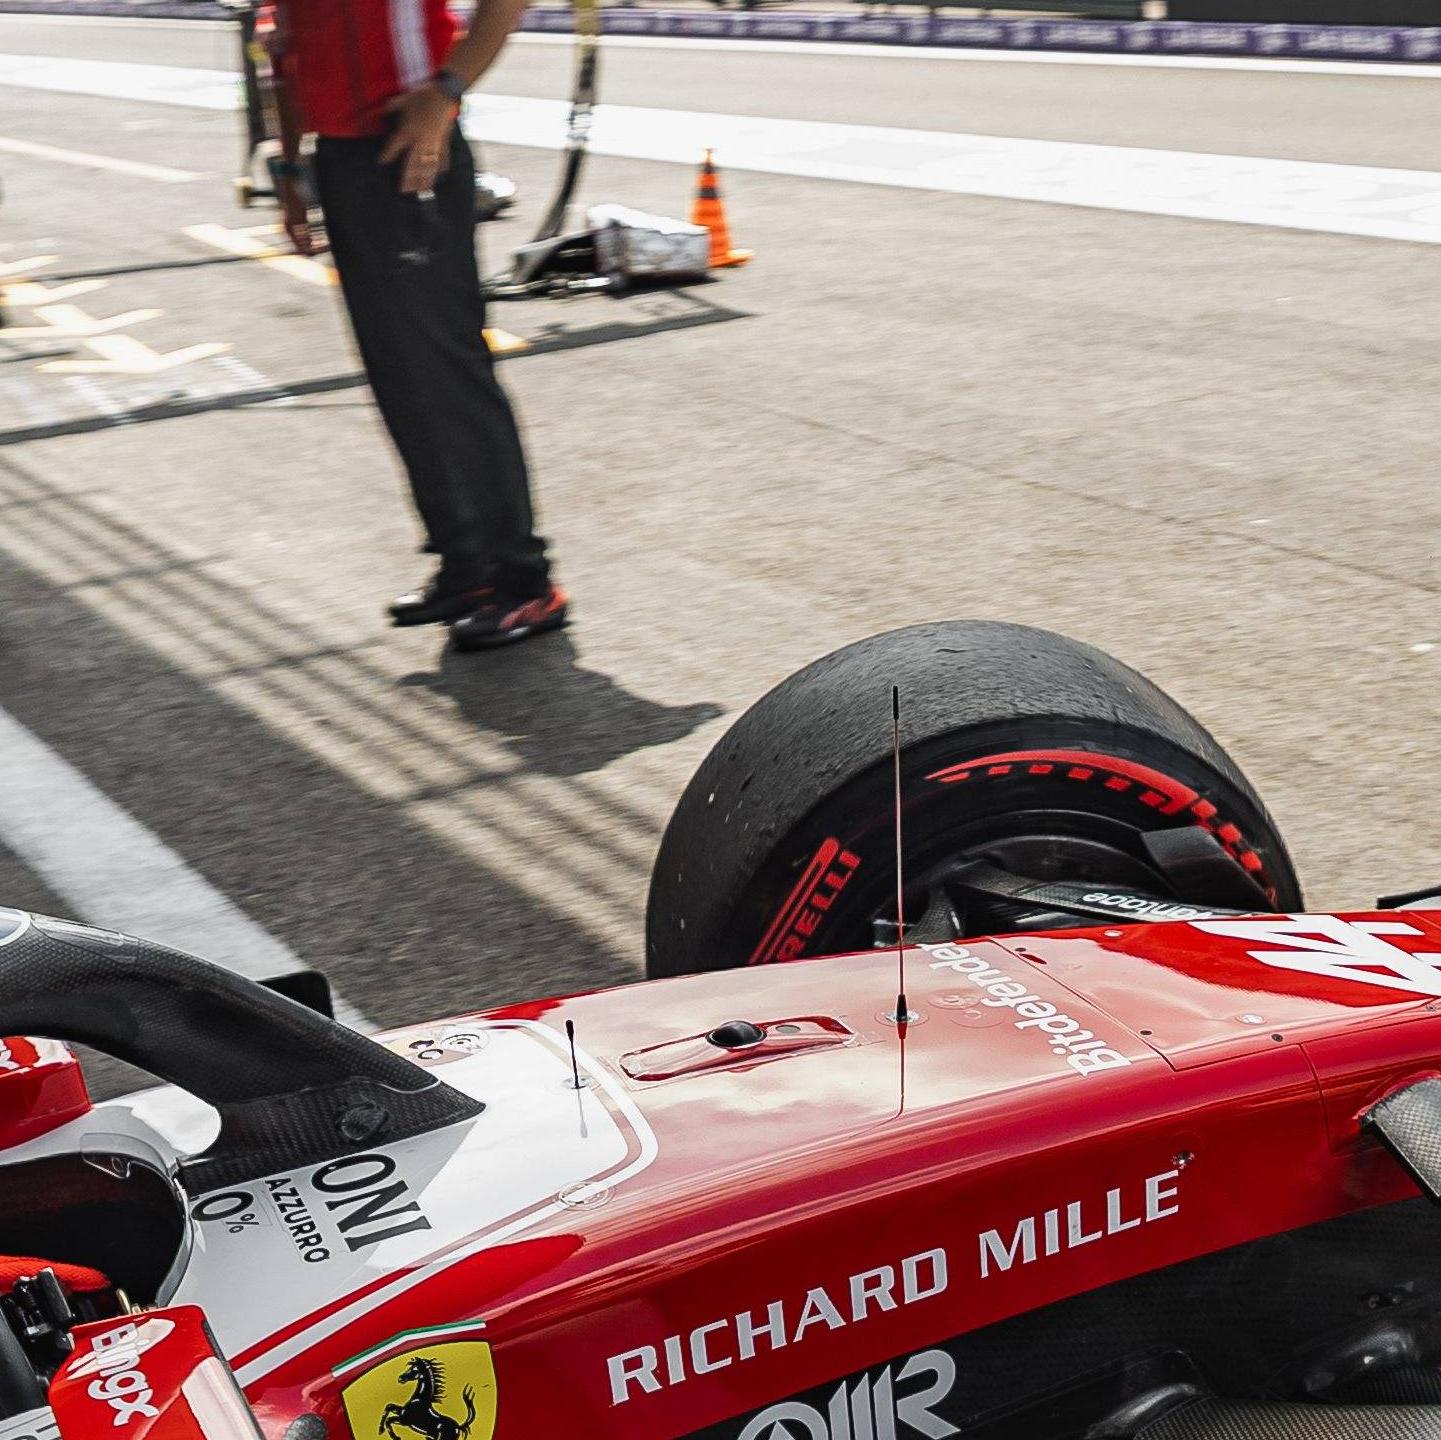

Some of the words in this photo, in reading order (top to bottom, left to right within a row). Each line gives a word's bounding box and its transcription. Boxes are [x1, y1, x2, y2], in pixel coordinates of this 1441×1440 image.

[916, 942, 1132, 1078] Bitdefender
[190, 1191, 260, 1234] 0%
[265, 1177, 331, 1264] AZZURRO
[311, 1153, 433, 1253] ONI
[606, 1248, 949, 1405] RICHARD
[980, 1169, 1180, 1279] MILLE
